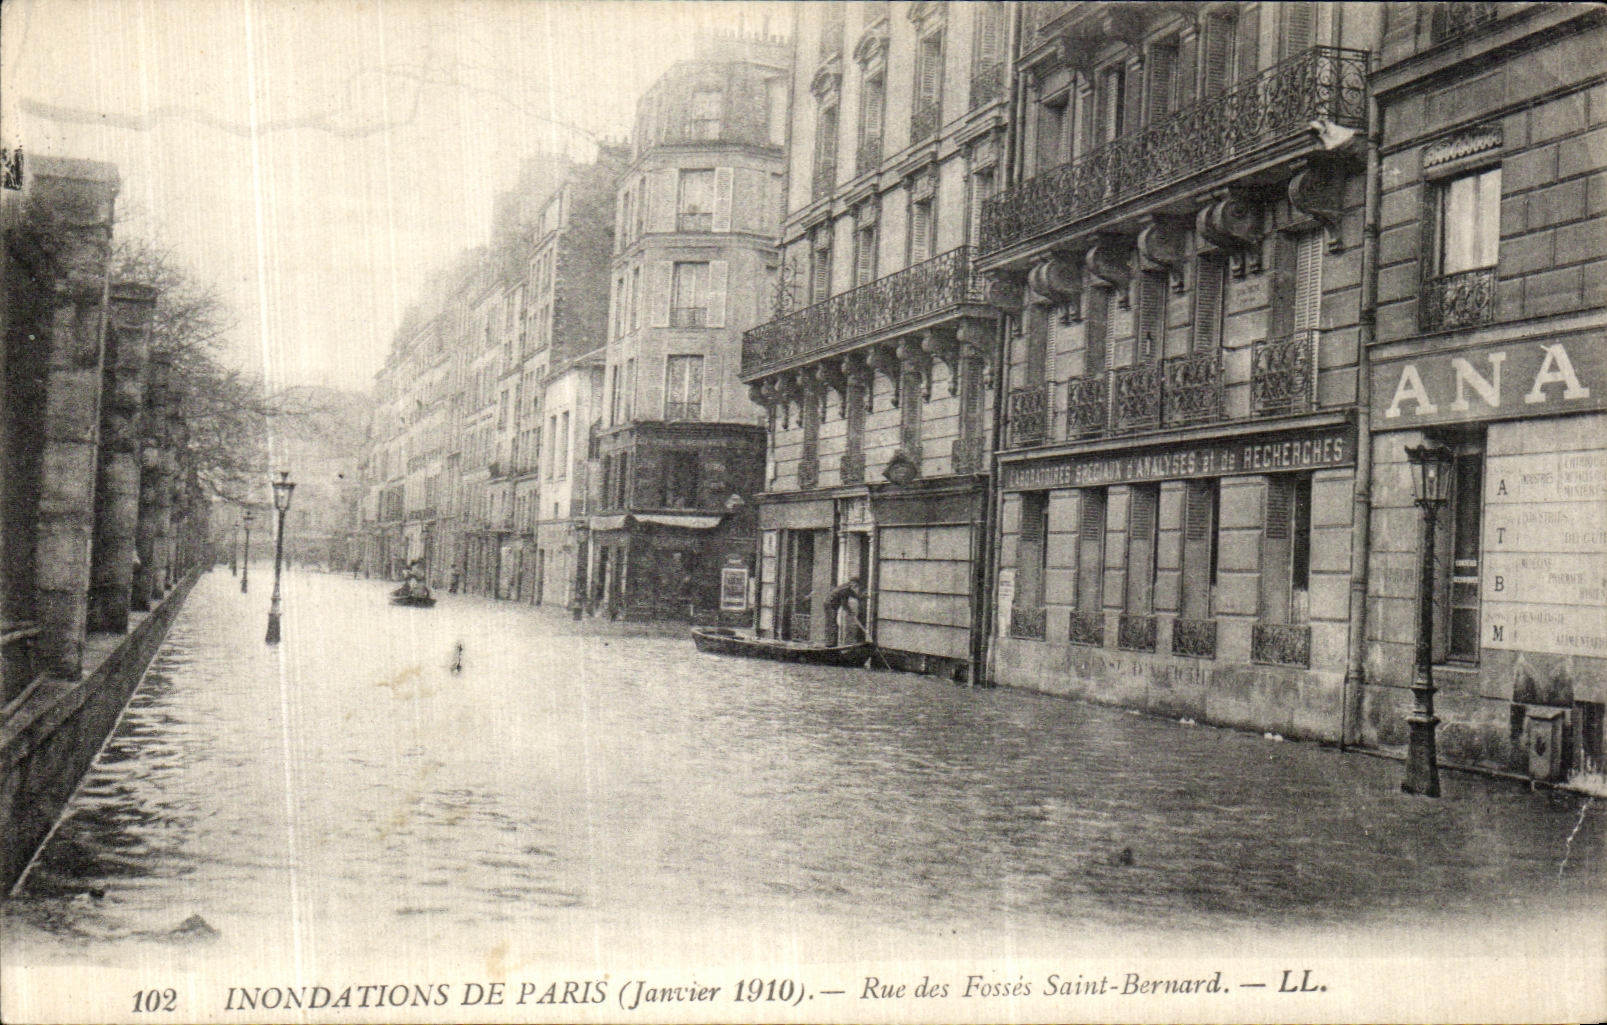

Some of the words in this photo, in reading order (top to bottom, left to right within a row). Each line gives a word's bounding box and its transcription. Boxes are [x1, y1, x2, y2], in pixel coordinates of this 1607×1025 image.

[1203, 451, 1215, 472] et
[1221, 450, 1236, 471] de
[1243, 437, 1345, 469] RECHERCHES
[1497, 479, 1508, 496] A
[1496, 527, 1506, 544] T
[1494, 575, 1505, 592] B
[1492, 625, 1504, 641] M
